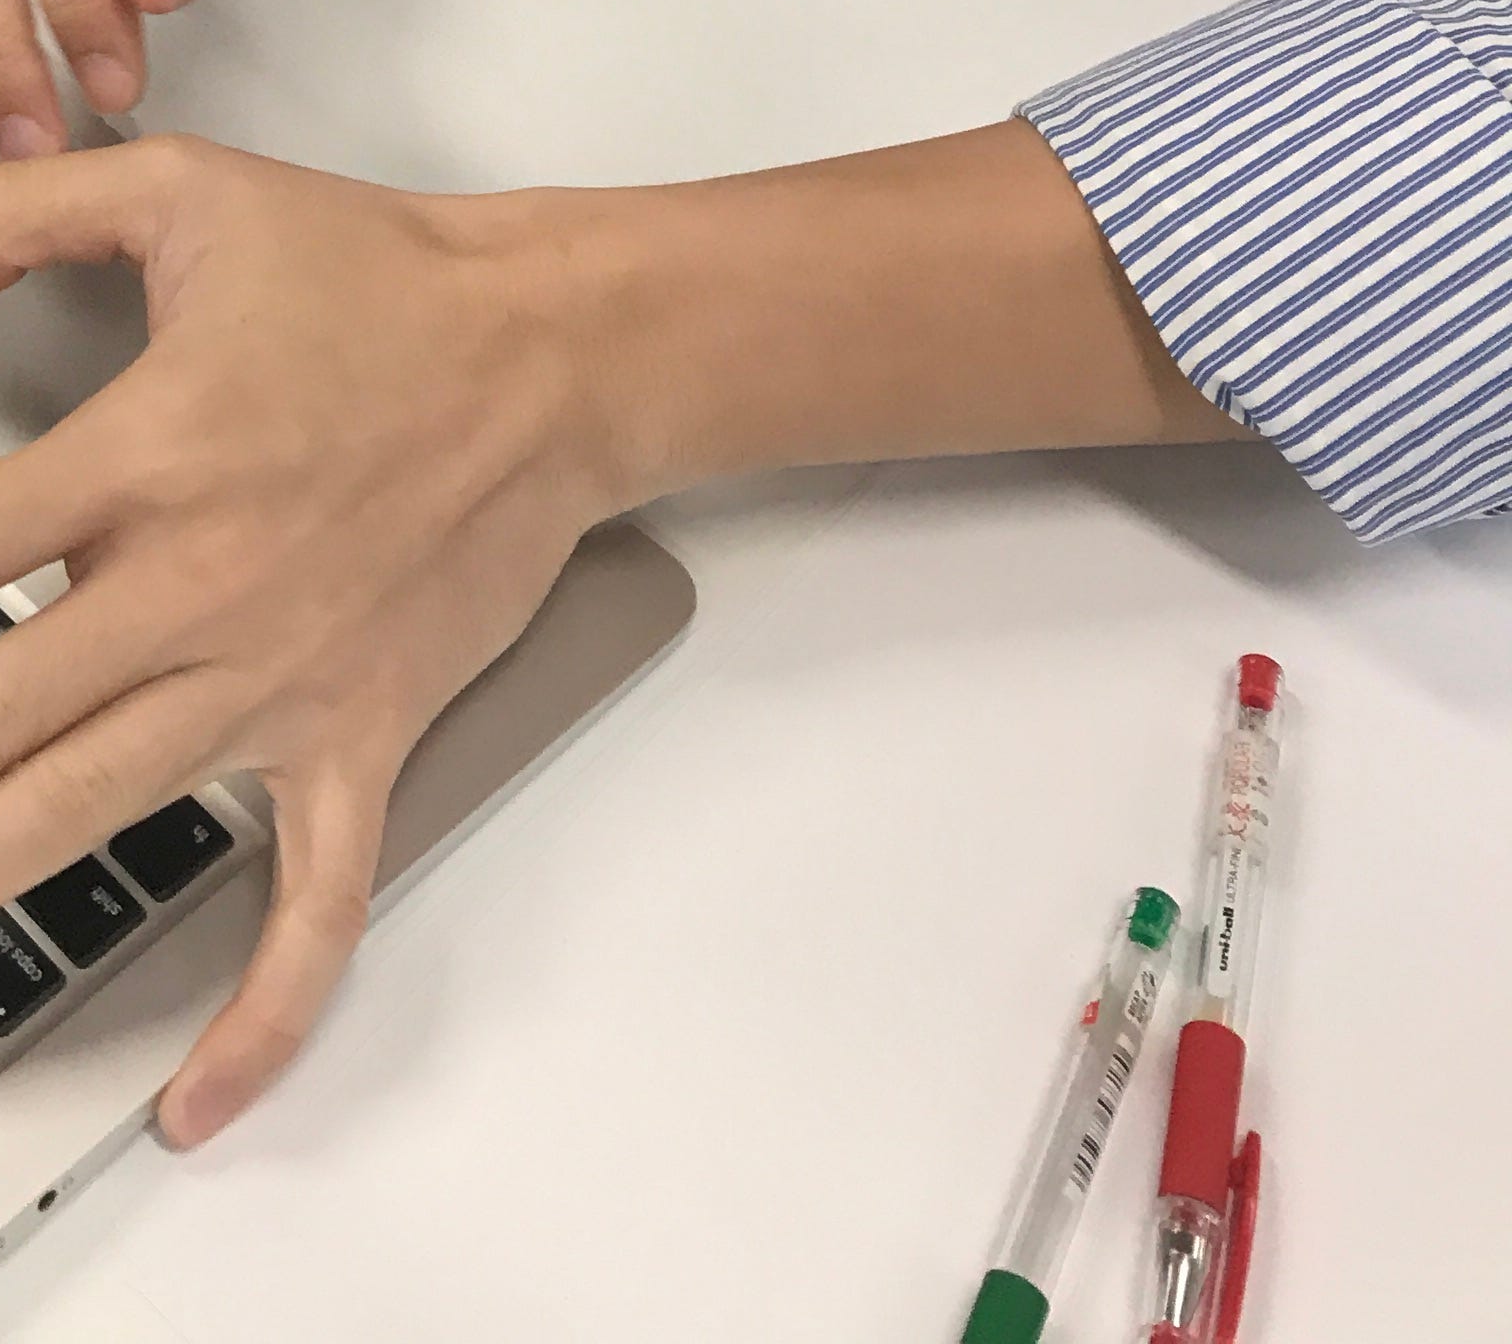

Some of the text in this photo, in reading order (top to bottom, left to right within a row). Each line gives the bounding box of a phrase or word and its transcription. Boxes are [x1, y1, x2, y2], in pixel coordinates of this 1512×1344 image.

[91, 886, 123, 916] shift
[1219, 906, 1234, 972] uni-ball
[11, 947, 43, 982] caps
